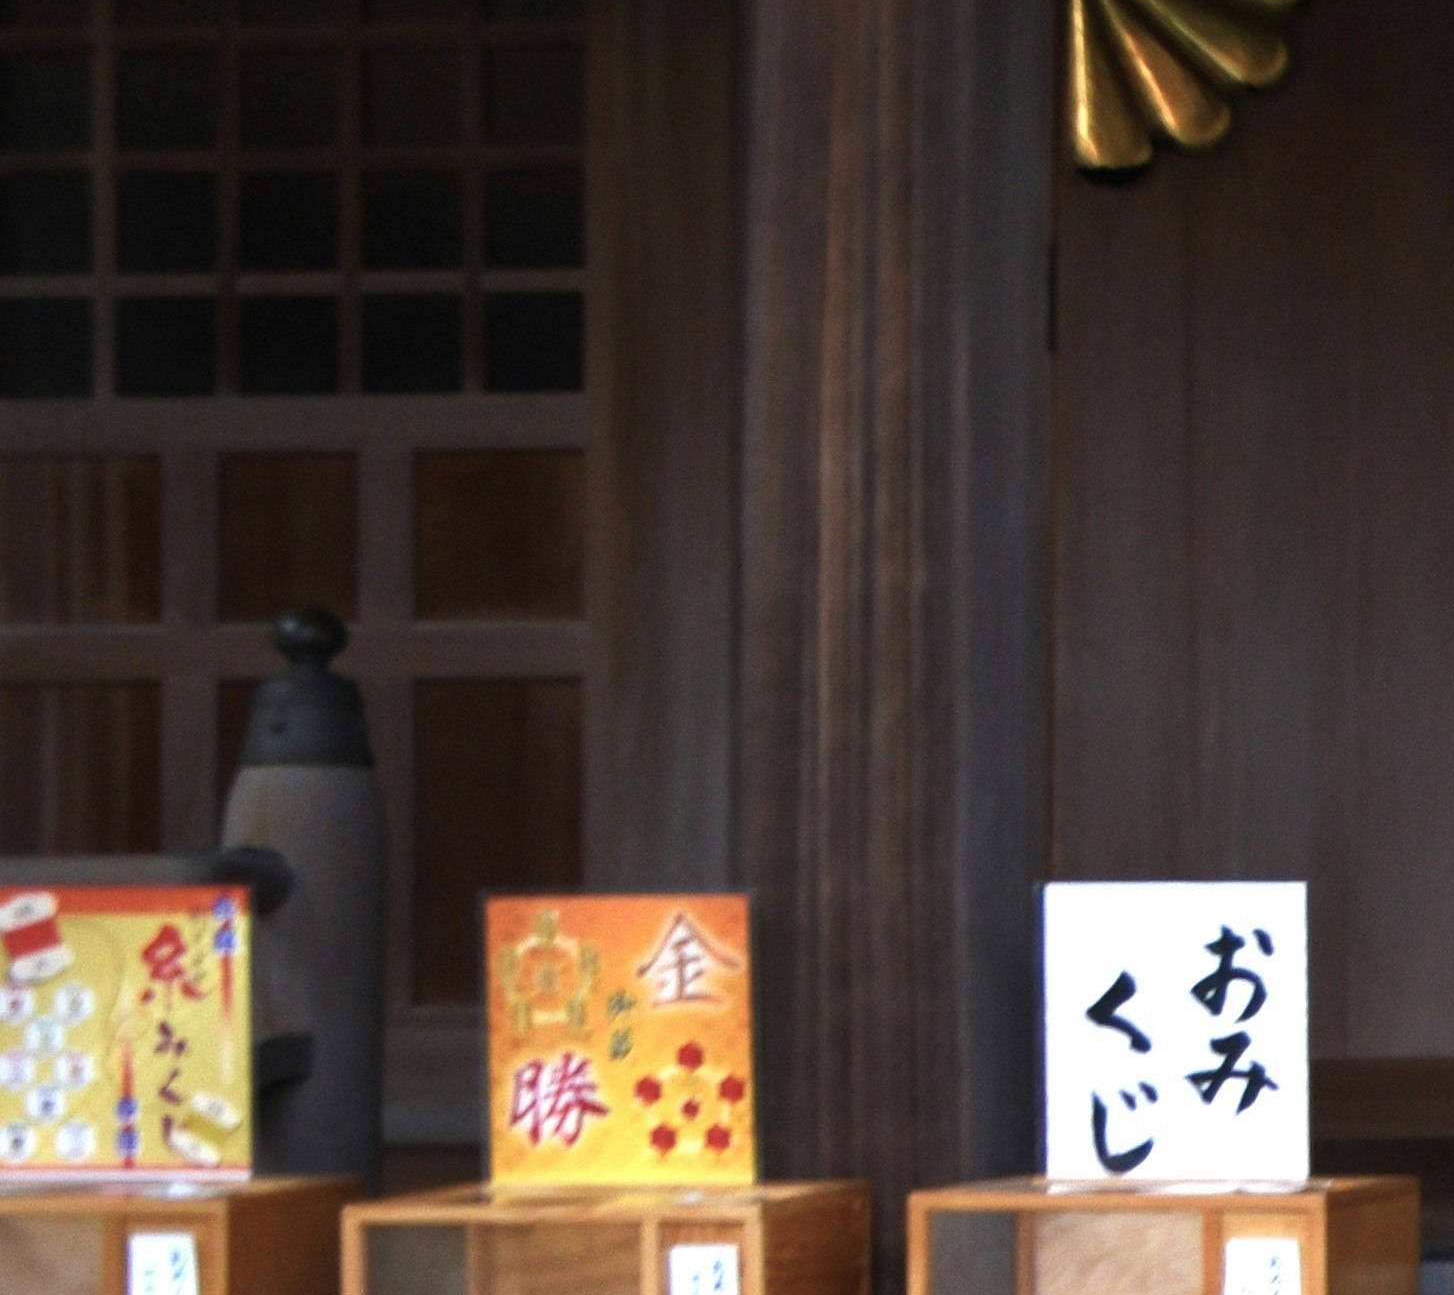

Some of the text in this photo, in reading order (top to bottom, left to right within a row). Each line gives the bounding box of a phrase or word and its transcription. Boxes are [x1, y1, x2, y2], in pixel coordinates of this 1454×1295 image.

[636, 910, 742, 1010] 金
[1184, 924, 1278, 1117] おみ
[510, 1050, 610, 1148] 勝
[1085, 970, 1160, 1173] くじ
